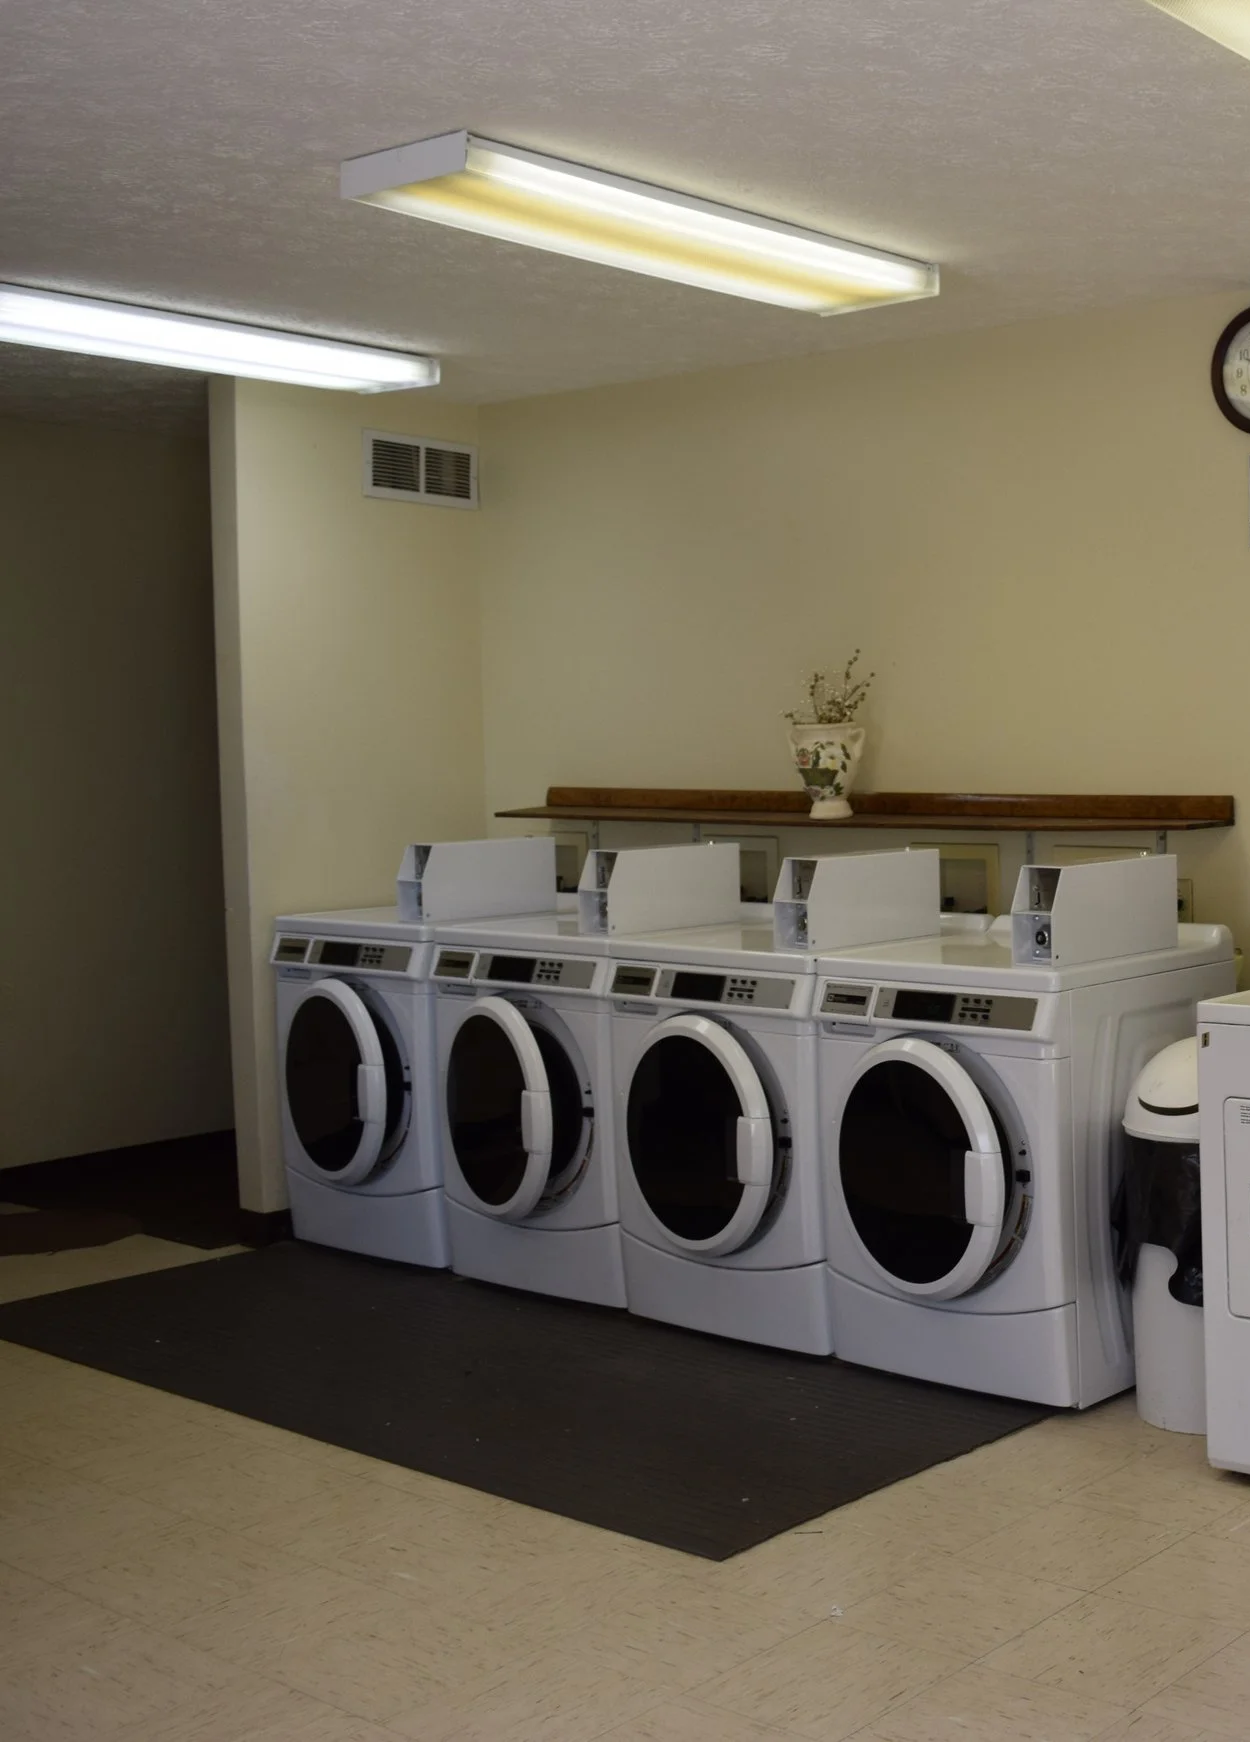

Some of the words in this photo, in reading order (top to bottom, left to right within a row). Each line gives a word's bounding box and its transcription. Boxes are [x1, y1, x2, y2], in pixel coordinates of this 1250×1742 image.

[1240, 349, 1249, 361] 10
[1236, 368, 1243, 379] 9
[1240, 384, 1247, 396] 8
